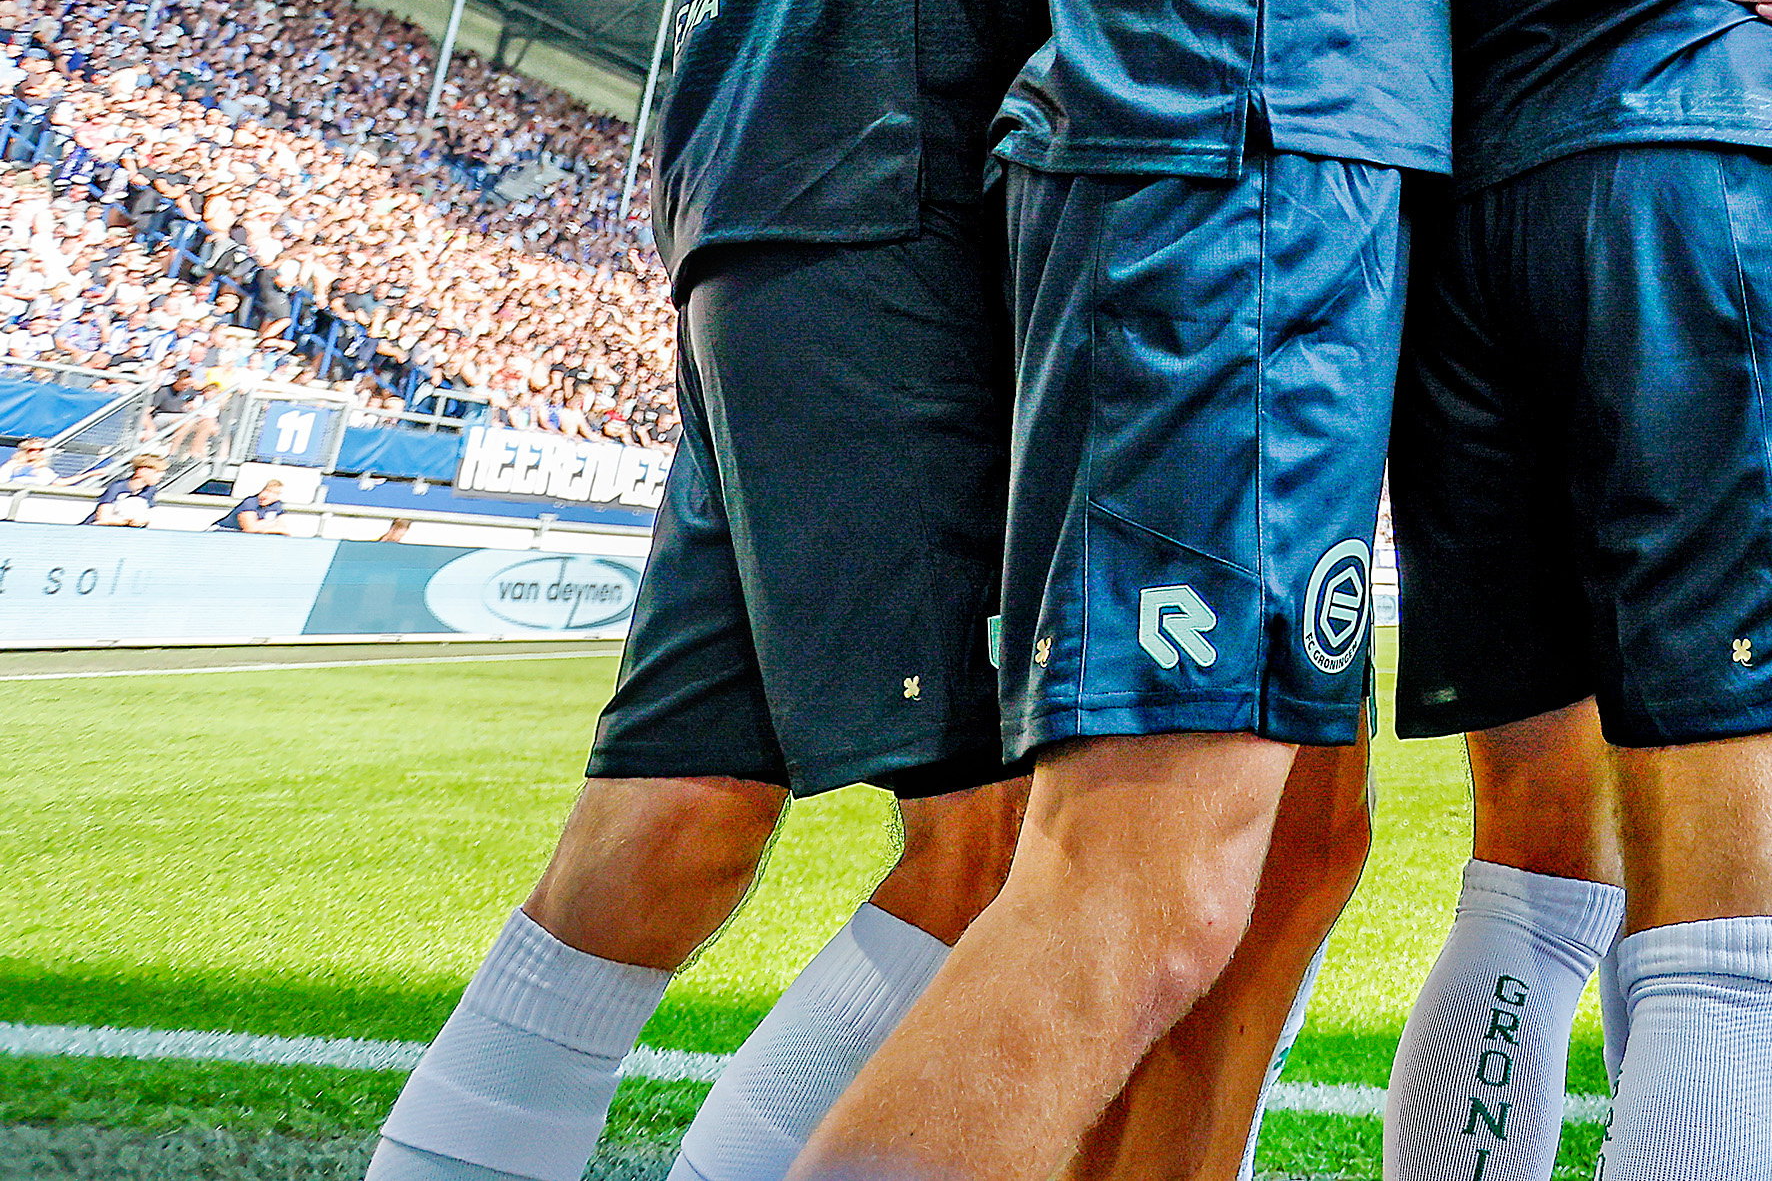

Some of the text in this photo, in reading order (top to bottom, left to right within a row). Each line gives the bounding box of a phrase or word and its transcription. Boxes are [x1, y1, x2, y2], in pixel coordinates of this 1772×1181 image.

[275, 409, 317, 455] 11
[498, 581, 540, 602] van
[1305, 632, 1357, 670] FC GRONINGEN
